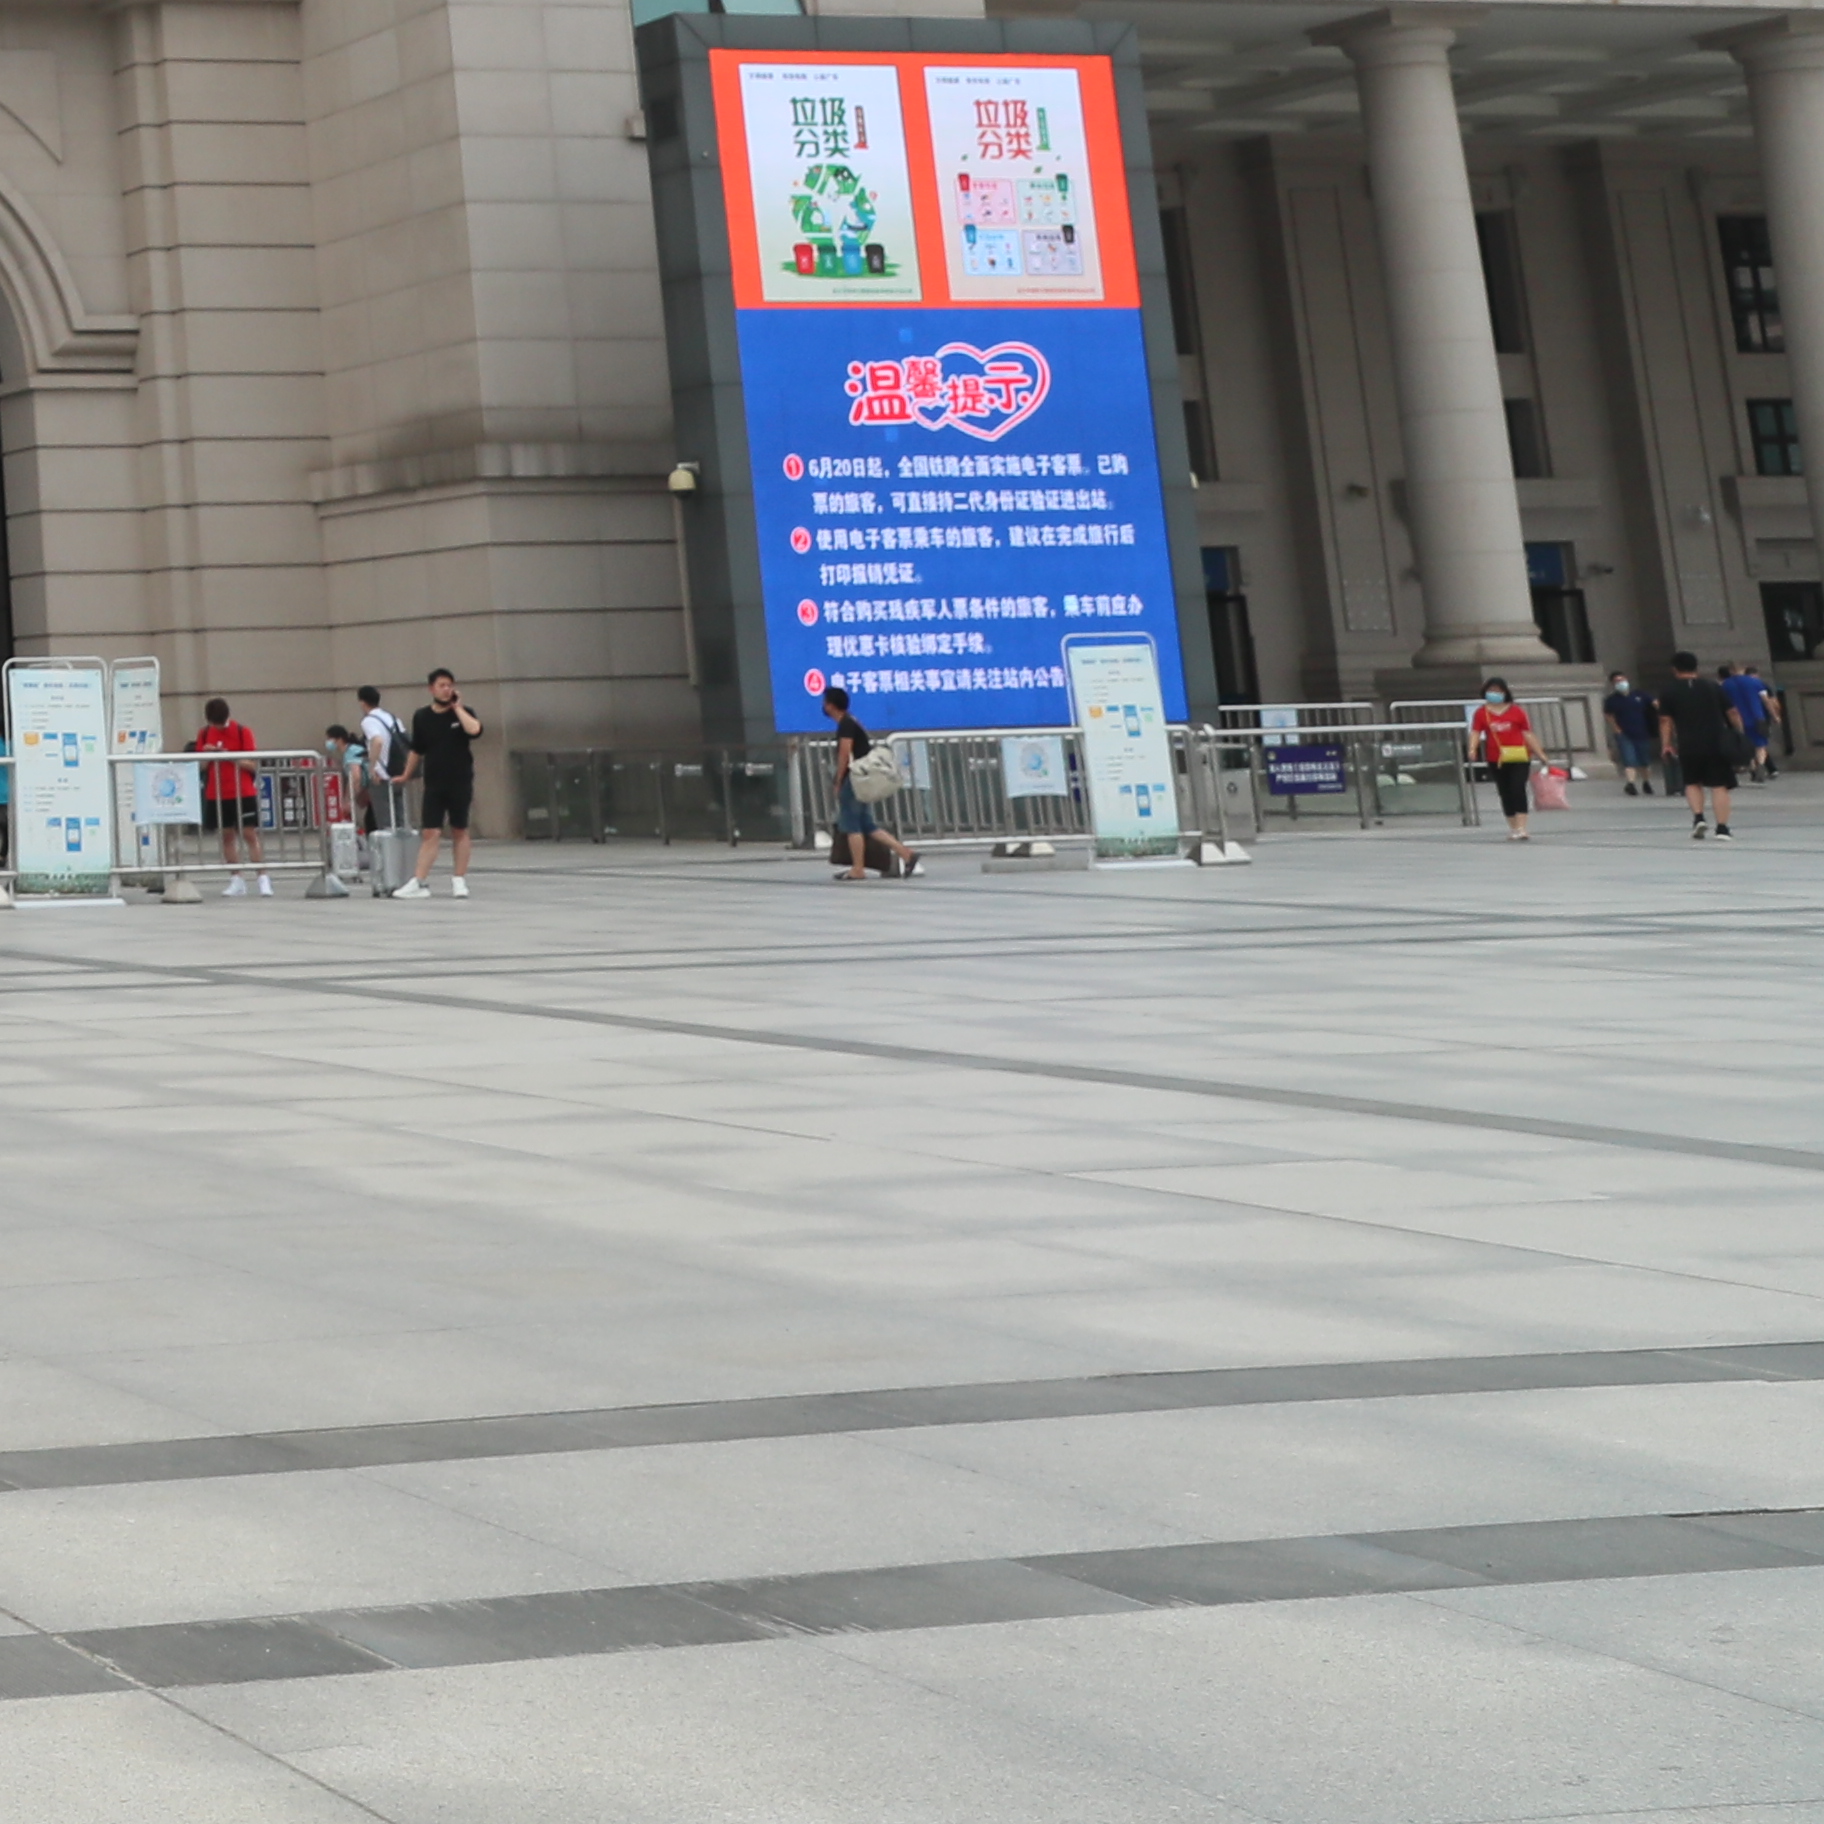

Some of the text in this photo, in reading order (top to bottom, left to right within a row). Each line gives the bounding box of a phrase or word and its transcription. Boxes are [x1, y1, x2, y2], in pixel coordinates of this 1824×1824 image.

[789, 96, 846, 127] 垃圾
[973, 99, 1028, 129] 垃圾
[793, 128, 850, 158] 分类
[977, 130, 1032, 160] 分类
[844, 356, 1032, 426] 温馨提示
